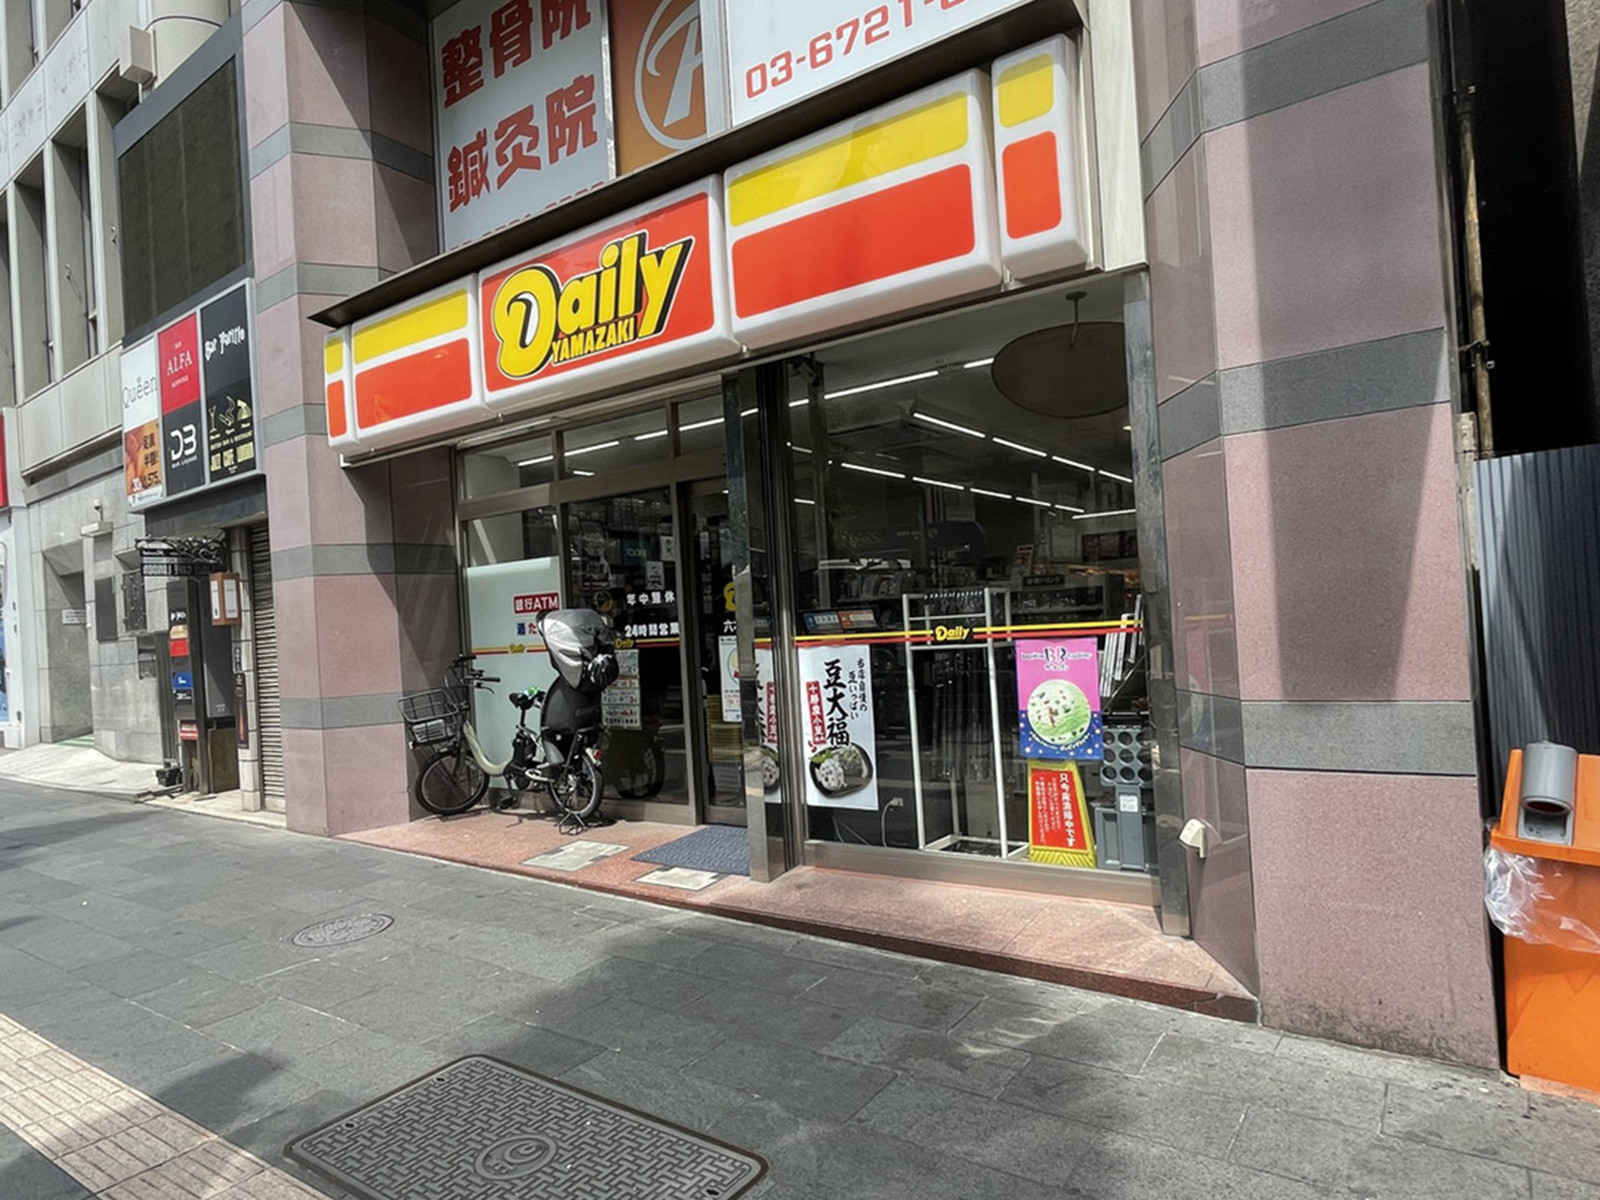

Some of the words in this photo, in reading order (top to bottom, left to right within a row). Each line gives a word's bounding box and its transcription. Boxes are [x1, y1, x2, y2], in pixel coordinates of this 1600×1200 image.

[442, 0, 591, 108] 整骨院
[746, 0, 966, 98] 03-6721-
[448, 74, 598, 213] 鍼灸院
[493, 231, 693, 377] Daily
[552, 317, 637, 363] YAMAZAKI
[167, 350, 193, 376] ALFA
[935, 625, 971, 641] Daily
[823, 659, 850, 746] 豆大福
